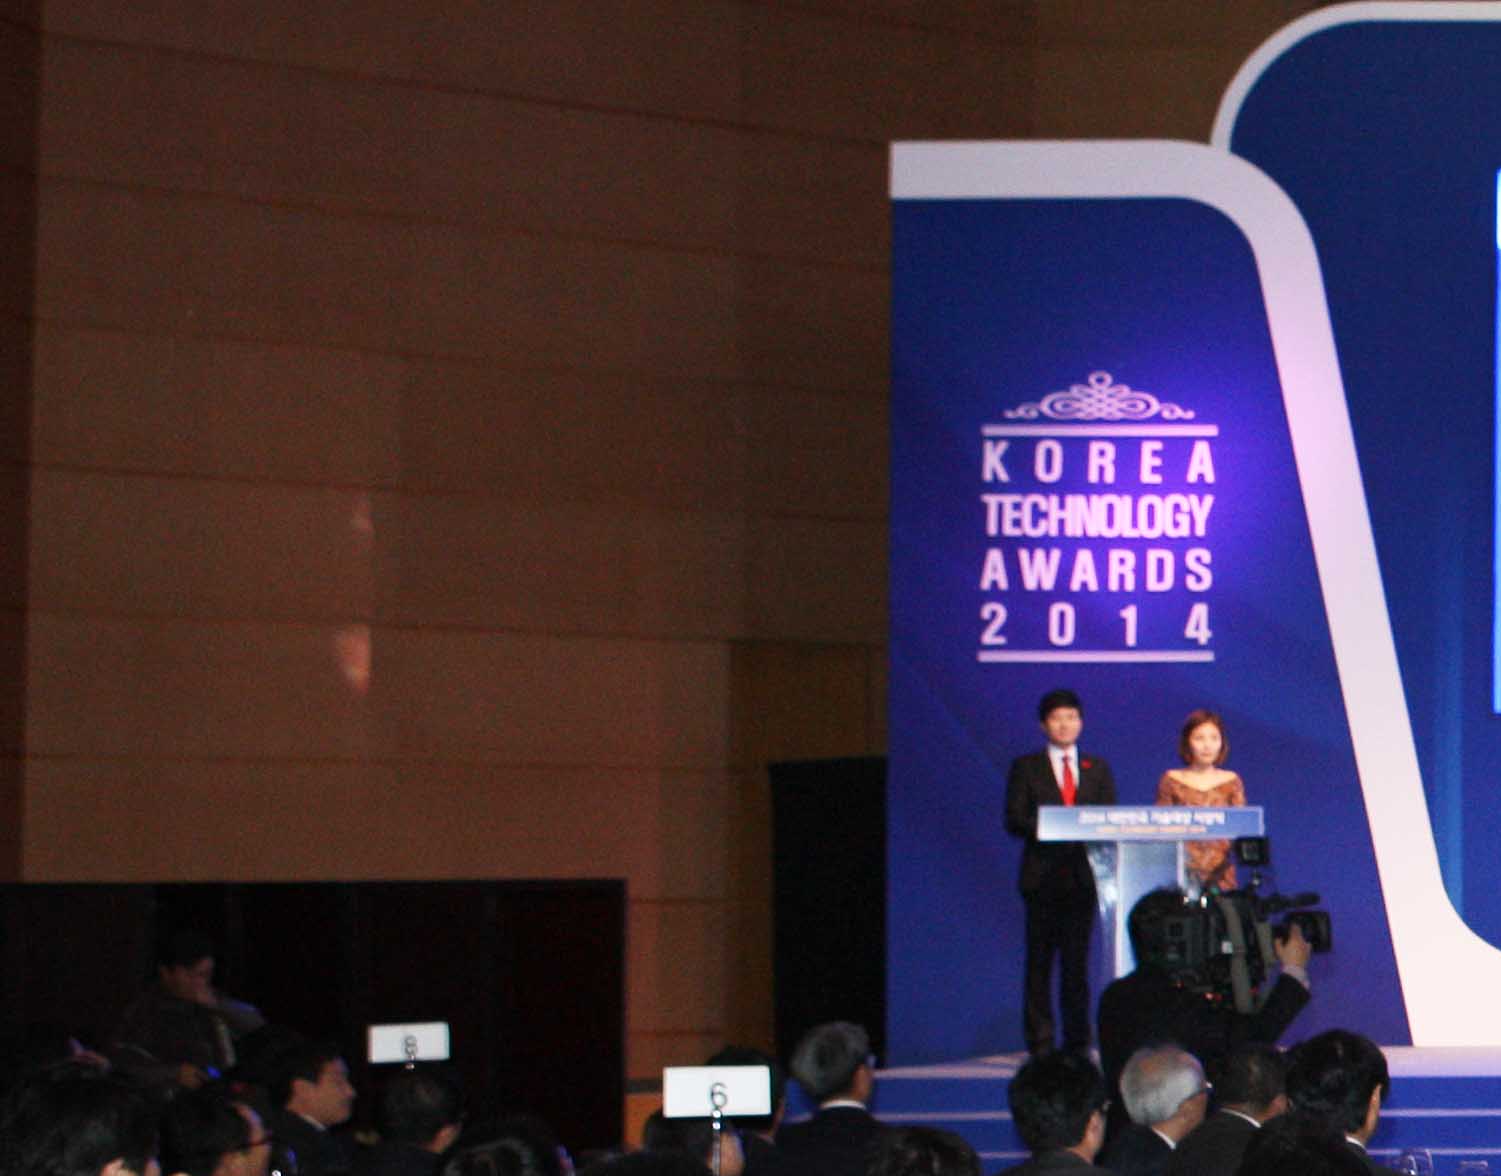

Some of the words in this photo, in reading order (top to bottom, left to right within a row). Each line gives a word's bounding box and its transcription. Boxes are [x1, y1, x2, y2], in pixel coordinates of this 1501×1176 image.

[980, 438, 1216, 485] KOREA
[979, 493, 1216, 539] TECHNOLOGY
[979, 546, 1214, 593] AWARDS
[979, 601, 1213, 648] 2014
[710, 1081, 728, 1110] 6
